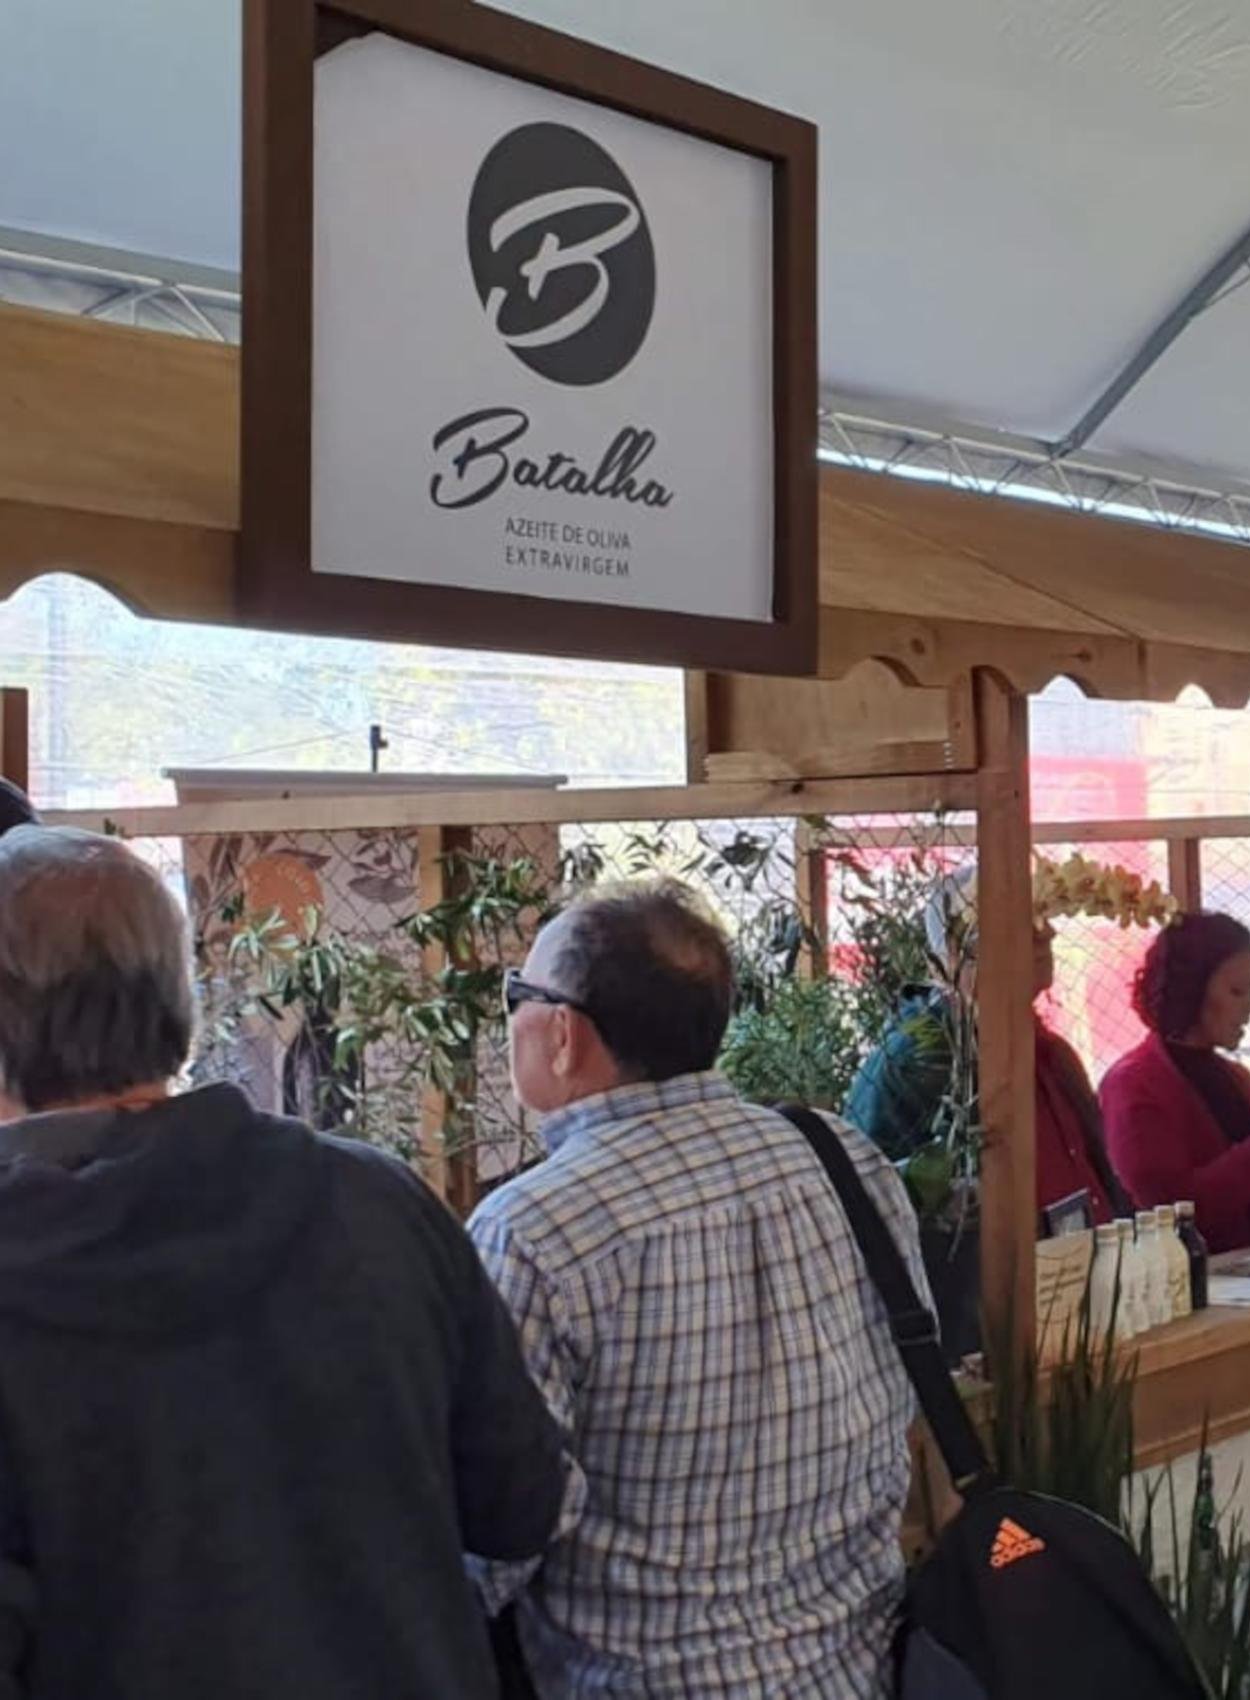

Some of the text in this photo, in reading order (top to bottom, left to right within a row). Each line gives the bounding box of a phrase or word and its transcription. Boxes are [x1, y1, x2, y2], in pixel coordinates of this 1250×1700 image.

[431, 407, 674, 509] Batalha
[505, 517, 631, 550] AZEITE DE OLIVA
[505, 545, 630, 576] EXTRAVIRGEM
